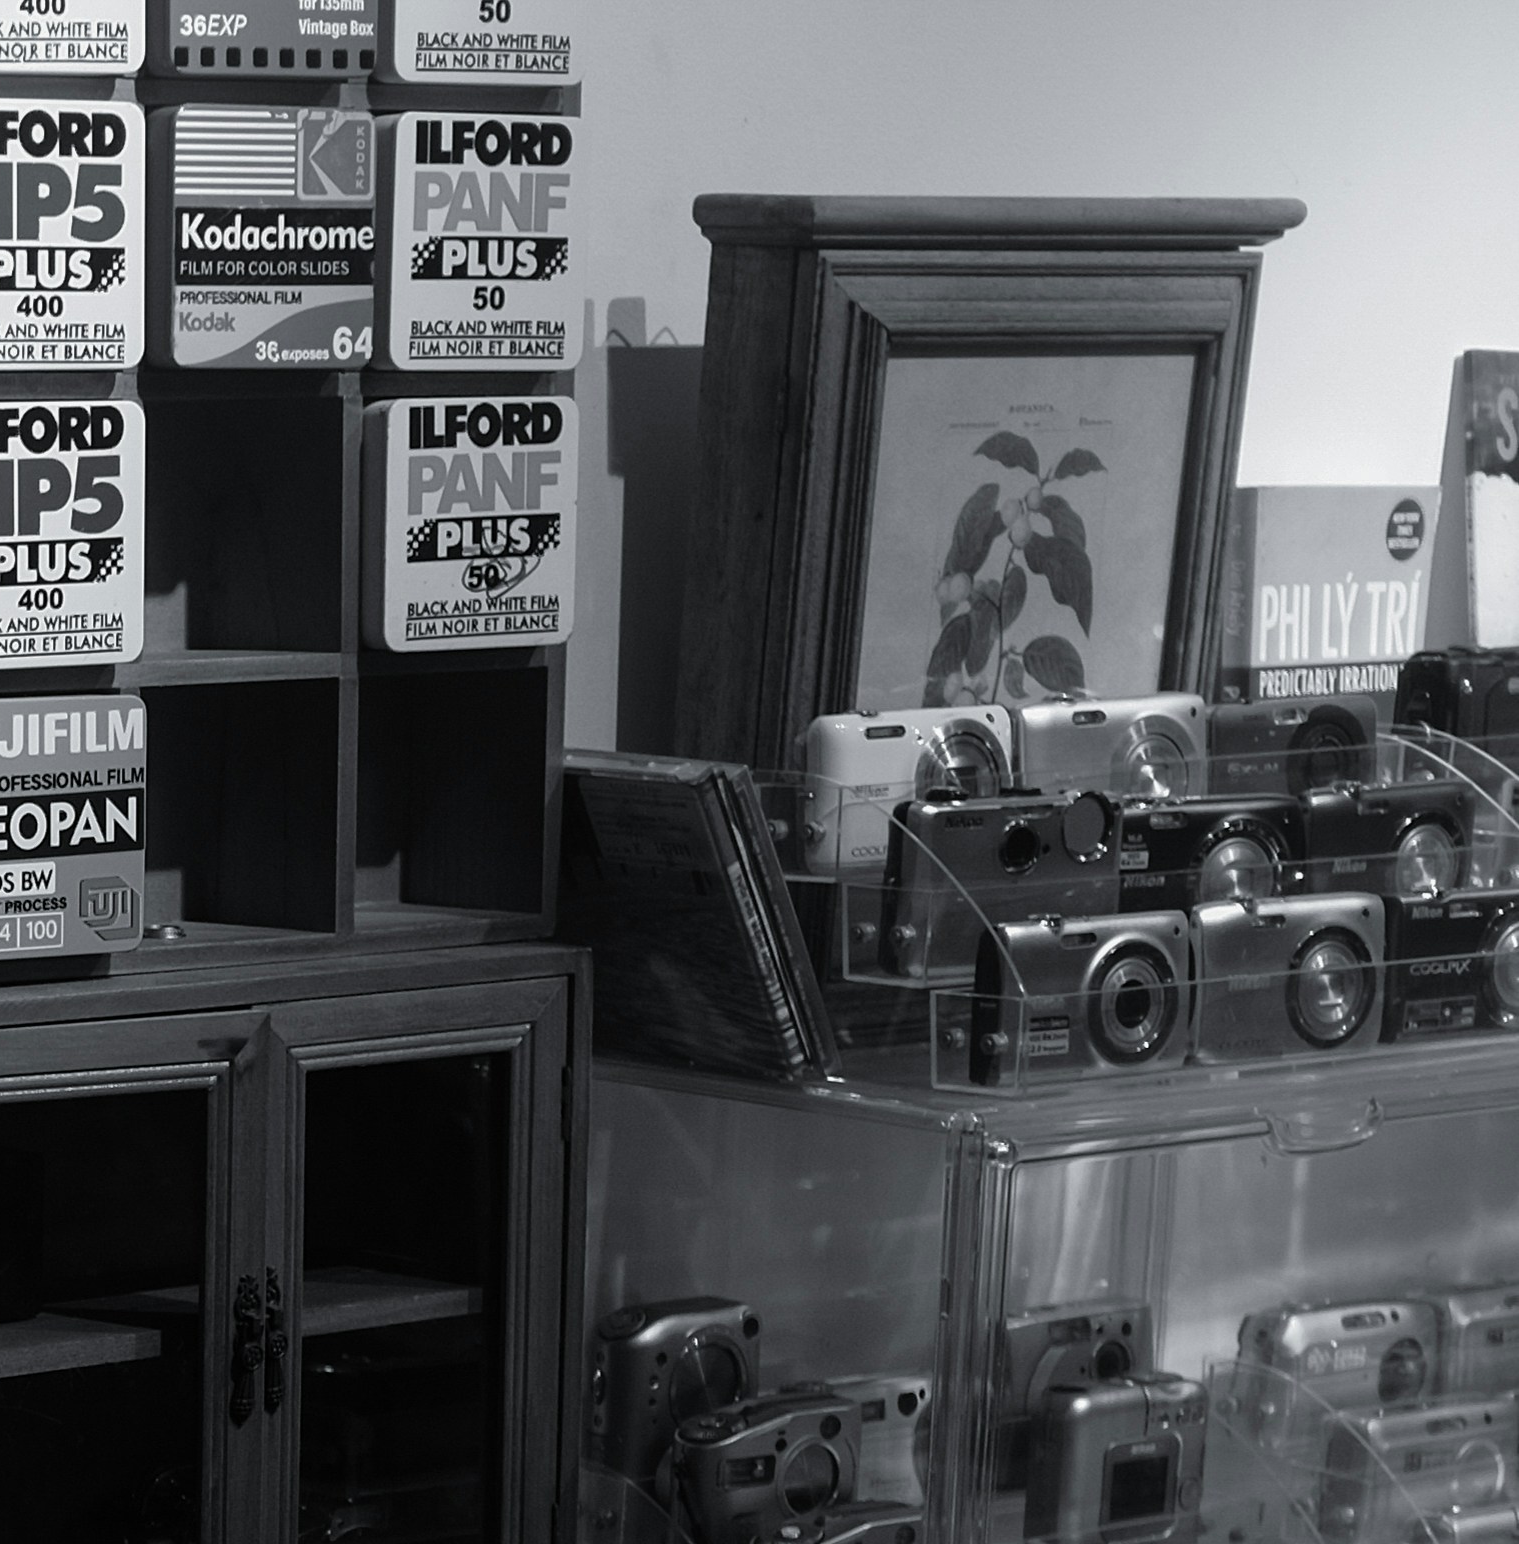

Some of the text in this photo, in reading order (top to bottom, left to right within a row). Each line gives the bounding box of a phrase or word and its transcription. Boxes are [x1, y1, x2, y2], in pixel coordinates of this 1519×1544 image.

[478, 0, 511, 23] 50
[8, 22, 41, 37] AND
[46, 22, 91, 38] WHITE
[97, 22, 128, 38] FILM
[180, 14, 248, 36] 36EXP
[298, 18, 374, 39] Vintage Box
[45, 43, 61, 59] ET
[67, 43, 128, 59] BLANCE
[417, 32, 571, 50] BLACK AND WHITE FILM
[415, 53, 570, 70] FILM NOIR ET BLANCE
[416, 119, 573, 167] ILFORD
[356, 125, 365, 190] KODAK
[412, 170, 571, 233] PANF
[182, 213, 374, 251] Kodachrome
[180, 261, 350, 276] FILM FOR COLOR SLIDES
[442, 239, 538, 278] PLUS
[16, 295, 64, 318] 400
[180, 291, 302, 305] PROFESSIONAL FILM
[472, 286, 506, 311] 50
[5, 323, 38, 339] AND
[43, 323, 89, 339] WHITE
[93, 323, 126, 339] FILM
[178, 312, 236, 332] Kodak
[411, 320, 566, 336] BLACK AND WHITE FILM
[41, 344, 58, 361] ET
[64, 344, 125, 361] BLANCE
[255, 341, 330, 363] 36 exposes
[332, 326, 373, 361] 64
[409, 340, 564, 356] FILM NOIR ET BLANCE
[409, 402, 563, 449] ILFORD
[407, 450, 561, 516] PANF
[436, 517, 531, 558] PLUS
[468, 565, 500, 589] 50
[17, 588, 64, 611] 400
[407, 594, 560, 617] BLACK AND WHITE FILM
[7, 616, 40, 633] AND
[44, 614, 88, 631] WHITE
[92, 612, 124, 628] FILM
[405, 614, 559, 637] FILM NOIR ET BLANCE
[1260, 569, 1422, 662] PHI LÝ TRÍ
[42, 636, 59, 651] ET
[64, 633, 123, 651] BLANCE
[1259, 667, 1337, 698] PREDICTABLY
[107, 767, 145, 785] FILM
[21, 868, 54, 891] BW
[4, 896, 68, 913] PROCESS
[26, 920, 58, 940] 100
